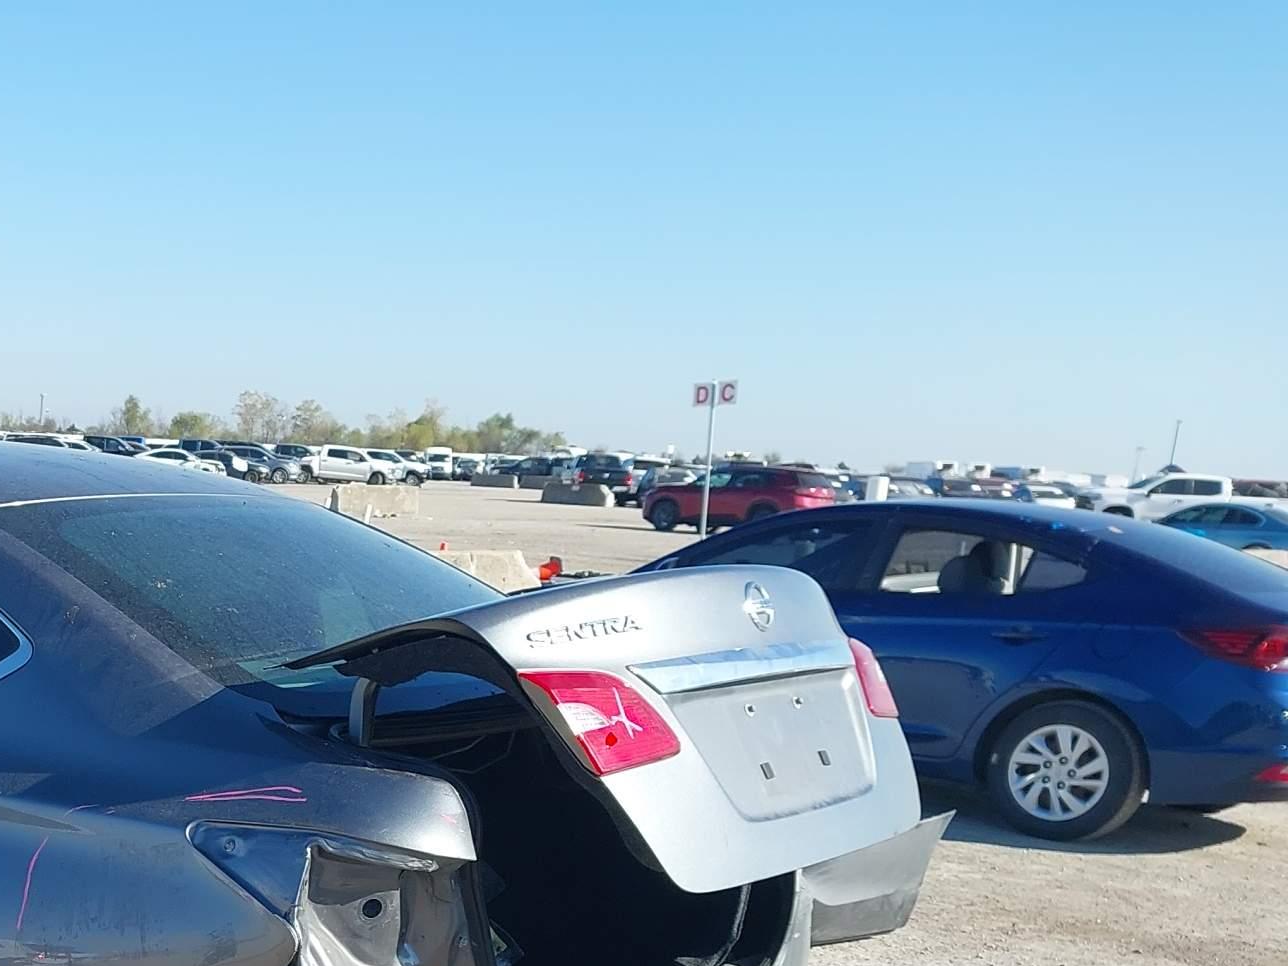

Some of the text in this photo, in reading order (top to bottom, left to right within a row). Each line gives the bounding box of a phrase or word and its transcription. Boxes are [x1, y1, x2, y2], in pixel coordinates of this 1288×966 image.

[696, 385, 710, 404] D
[720, 383, 736, 402] C
[525, 614, 644, 649] SENTRA
